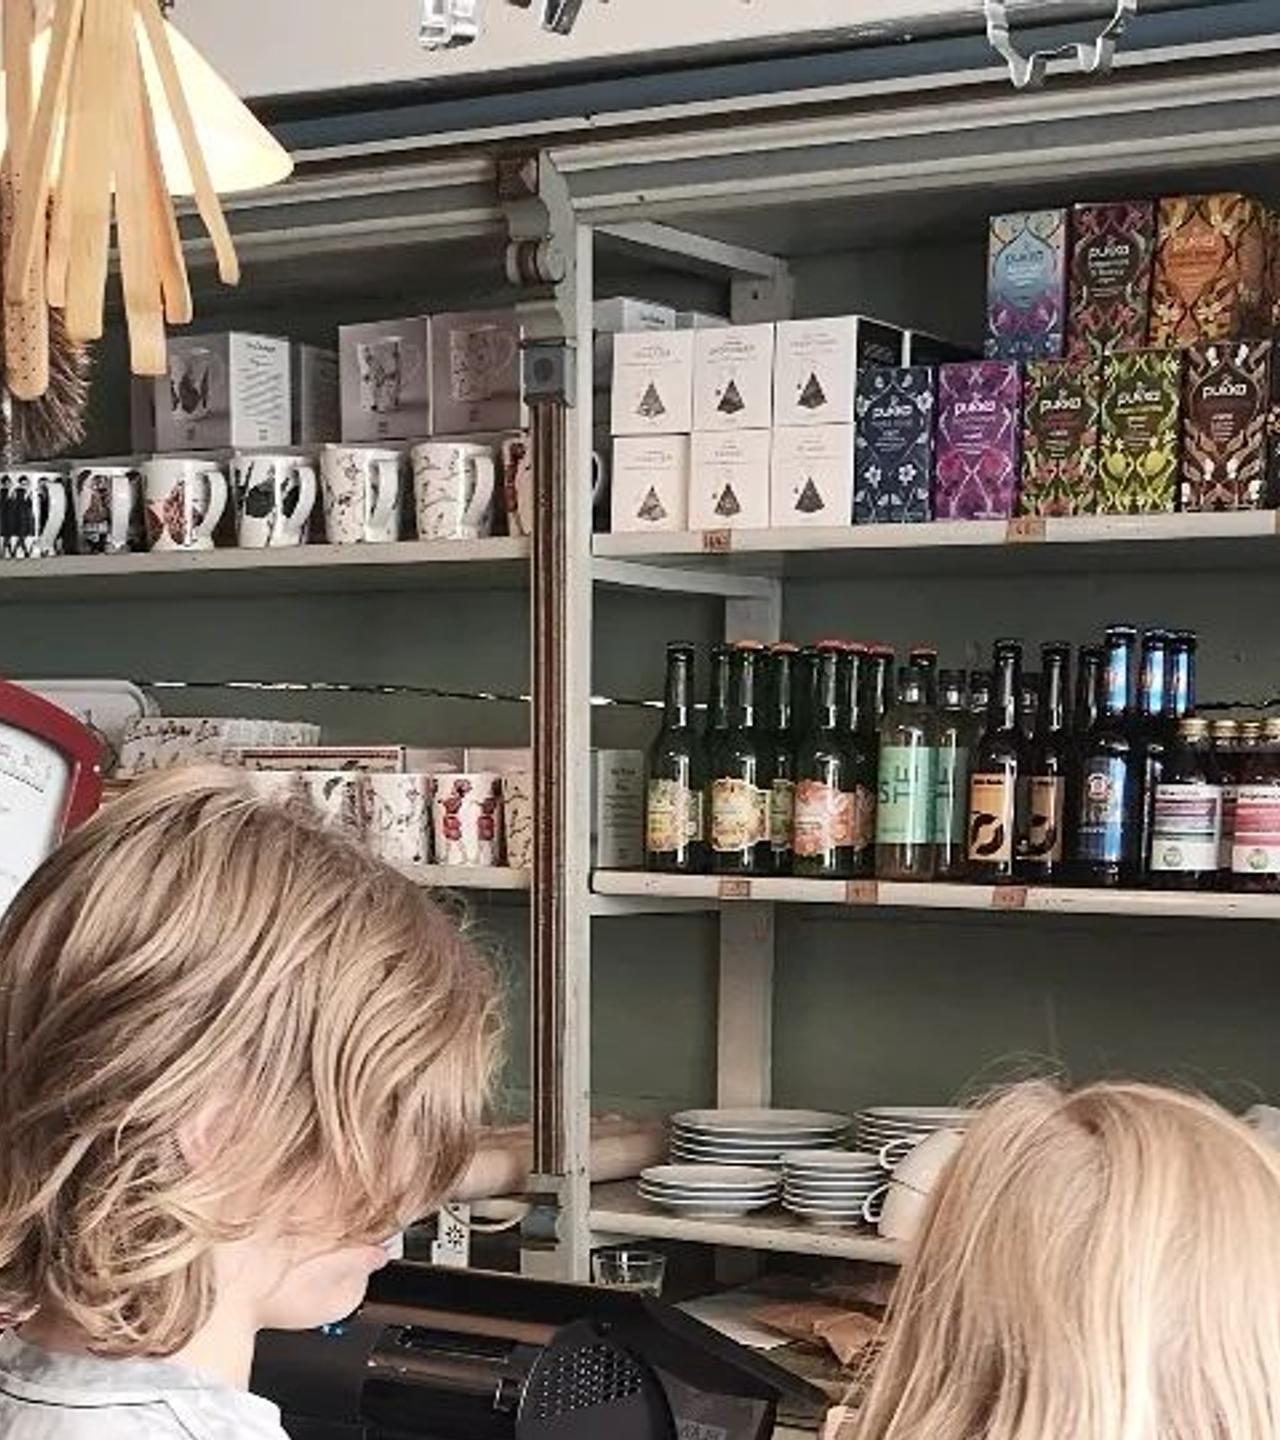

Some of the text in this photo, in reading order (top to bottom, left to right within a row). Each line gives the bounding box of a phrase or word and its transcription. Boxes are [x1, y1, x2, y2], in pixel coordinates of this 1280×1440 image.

[1088, 245, 1129, 259] pukka
[1117, 390, 1161, 407] pukka
[1202, 383, 1247, 399] pukka
[954, 400, 996, 415] pukka
[1040, 397, 1081, 413] pukka
